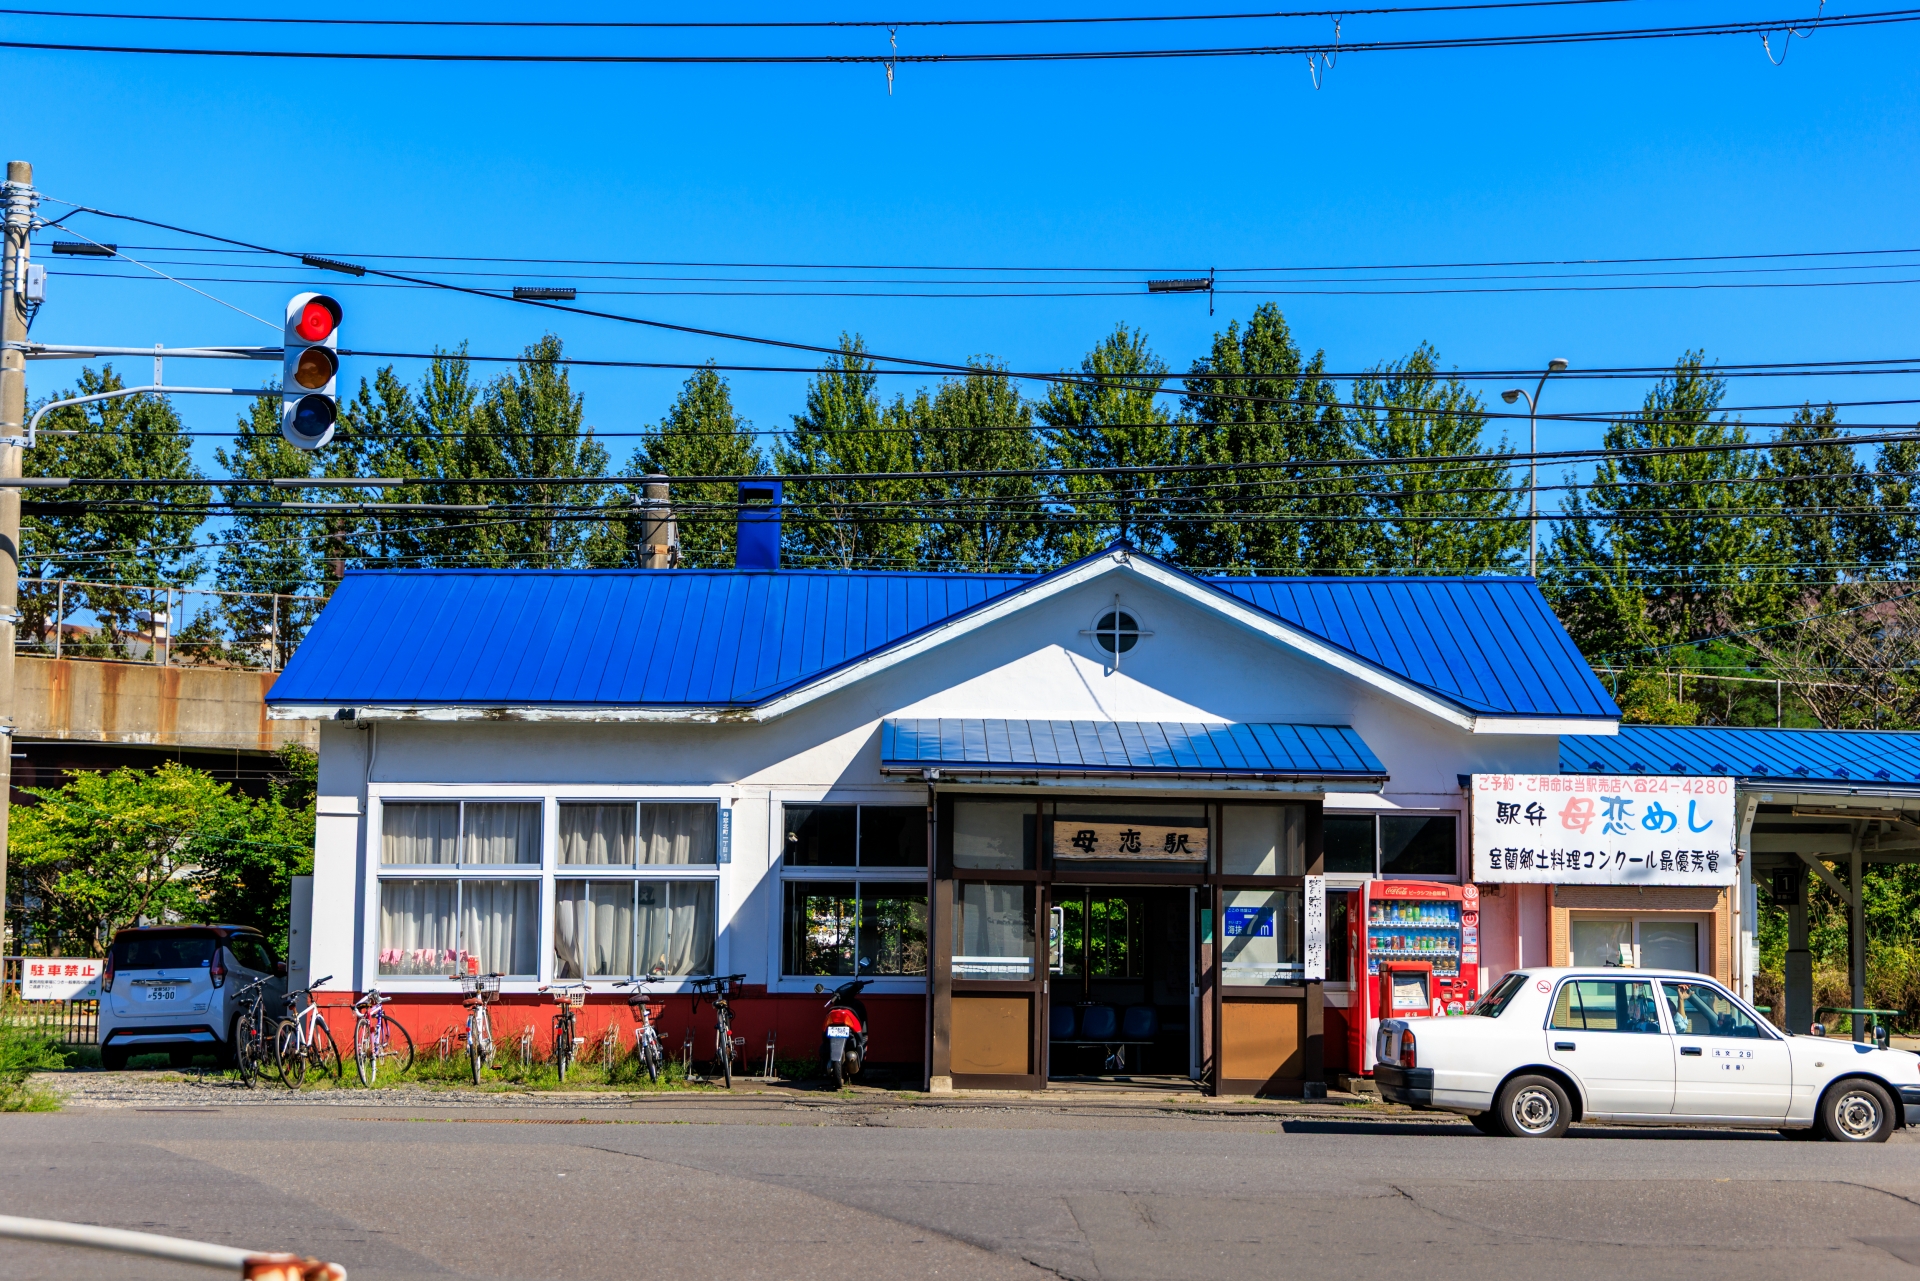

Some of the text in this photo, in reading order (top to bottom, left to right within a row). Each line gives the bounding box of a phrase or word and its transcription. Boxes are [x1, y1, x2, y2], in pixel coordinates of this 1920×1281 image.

[1495, 796, 1713, 835] 駅弁 母恋めし
[1071, 828, 1193, 854] 母恋駅
[1489, 847, 1720, 873] 室蘭郷土料理コンクール最優秀賞
[1227, 925, 1243, 935] 海抜
[1243, 914, 1259, 935] 7
[30, 963, 95, 977] 駐車禁止
[87, 989, 97, 997] JR
